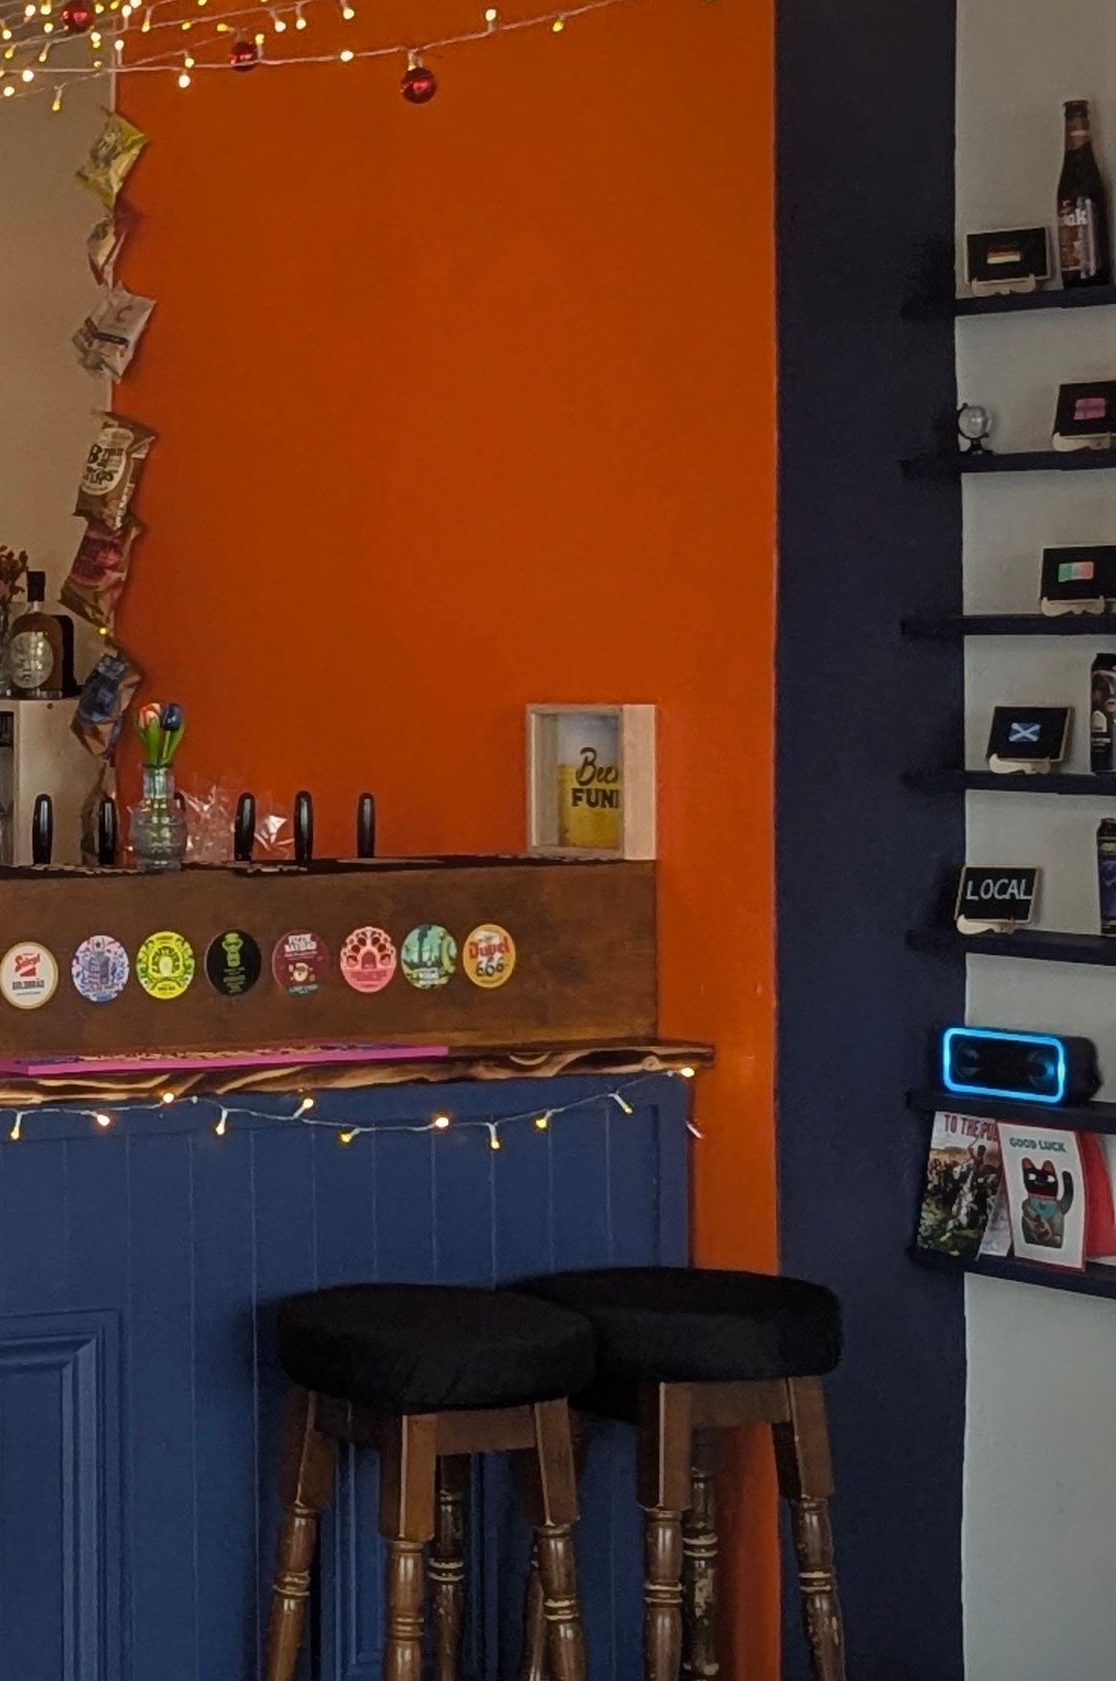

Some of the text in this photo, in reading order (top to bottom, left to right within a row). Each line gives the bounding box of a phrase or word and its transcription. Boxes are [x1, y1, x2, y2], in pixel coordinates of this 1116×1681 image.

[966, 878, 1033, 901] LOCAL
[469, 935, 510, 960] Duvel
[476, 956, 505, 977] 666
[945, 1114, 958, 1134] TO
[961, 1117, 979, 1138] THE
[1009, 1136, 1067, 1152] GOOD LUCK
